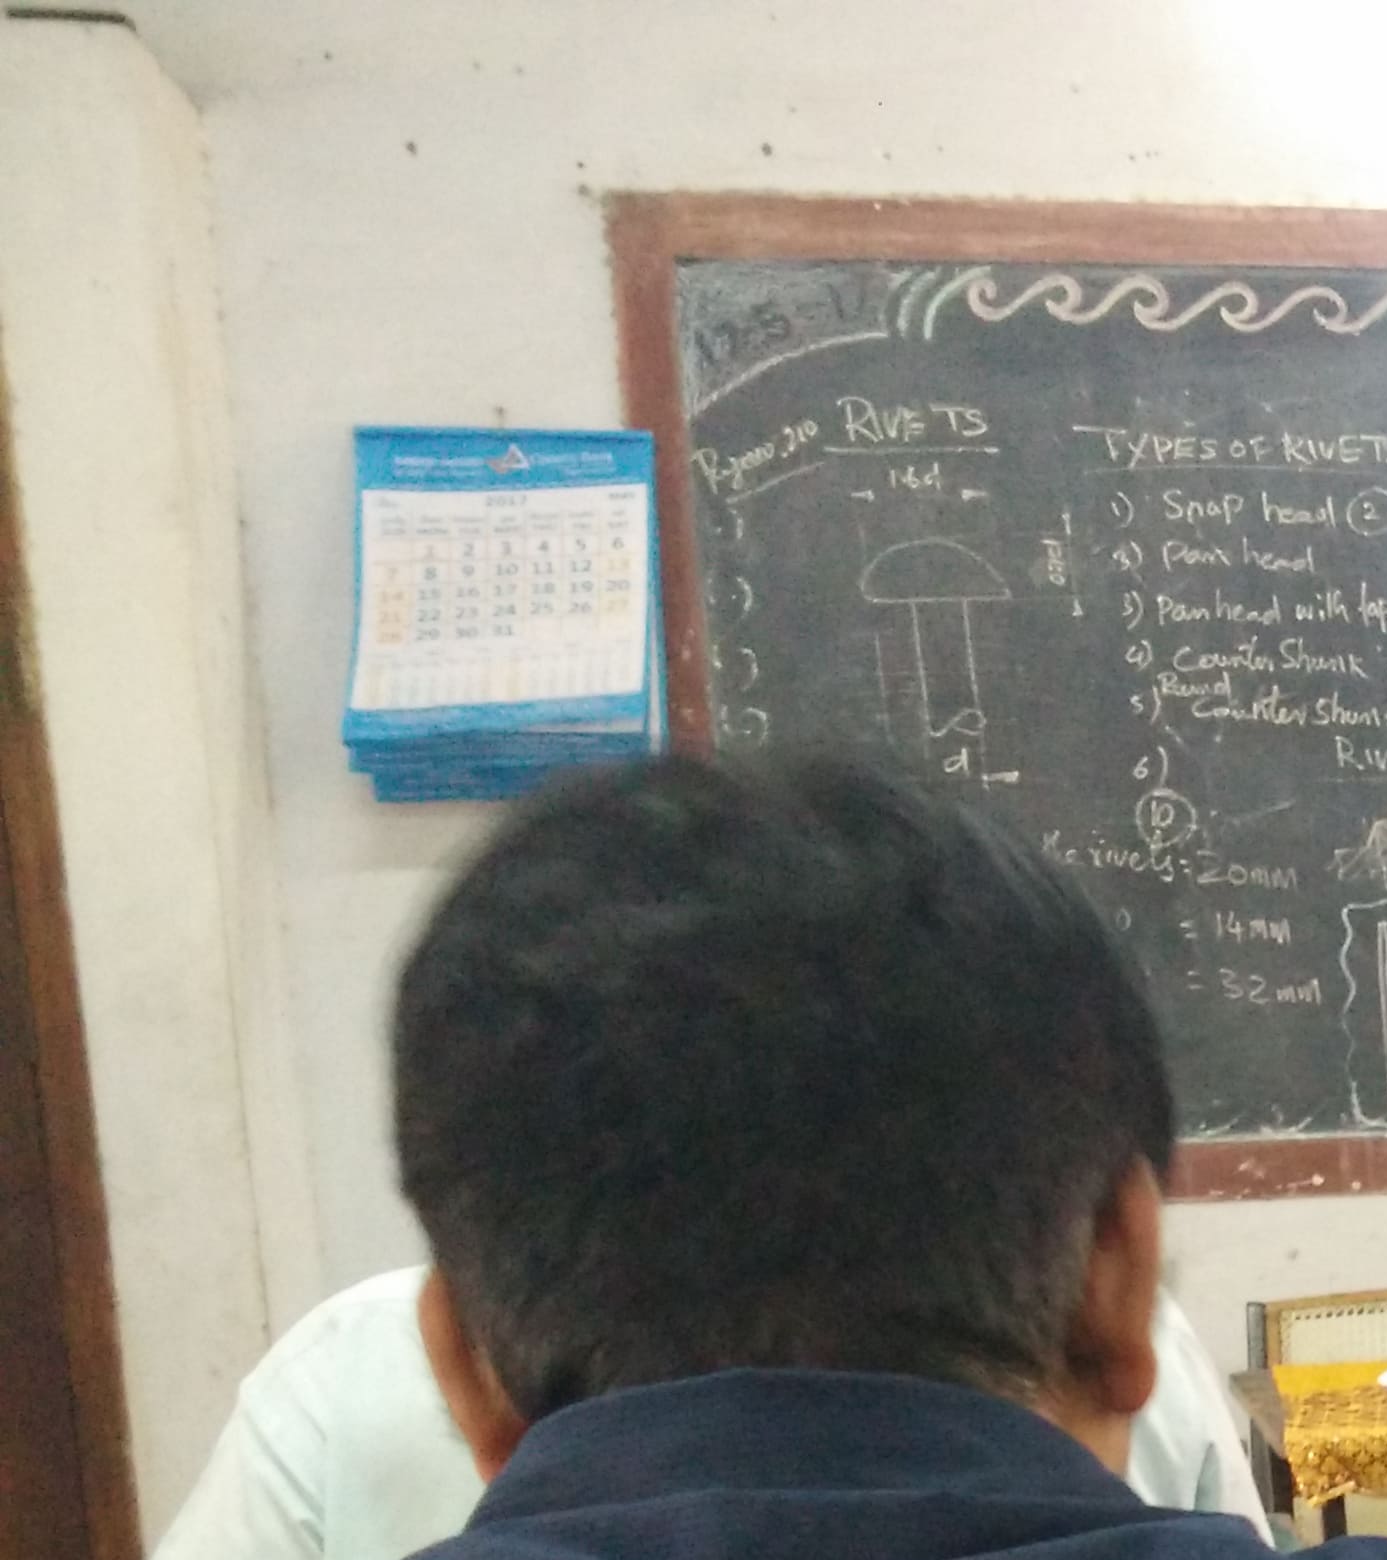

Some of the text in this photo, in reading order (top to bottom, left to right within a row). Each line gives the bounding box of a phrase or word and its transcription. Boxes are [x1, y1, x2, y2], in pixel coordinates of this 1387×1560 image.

[836, 396, 988, 442] RIVETS
[1163, 489, 1243, 526] Snap
[1262, 490, 1336, 529] head
[1214, 588, 1282, 626] head
